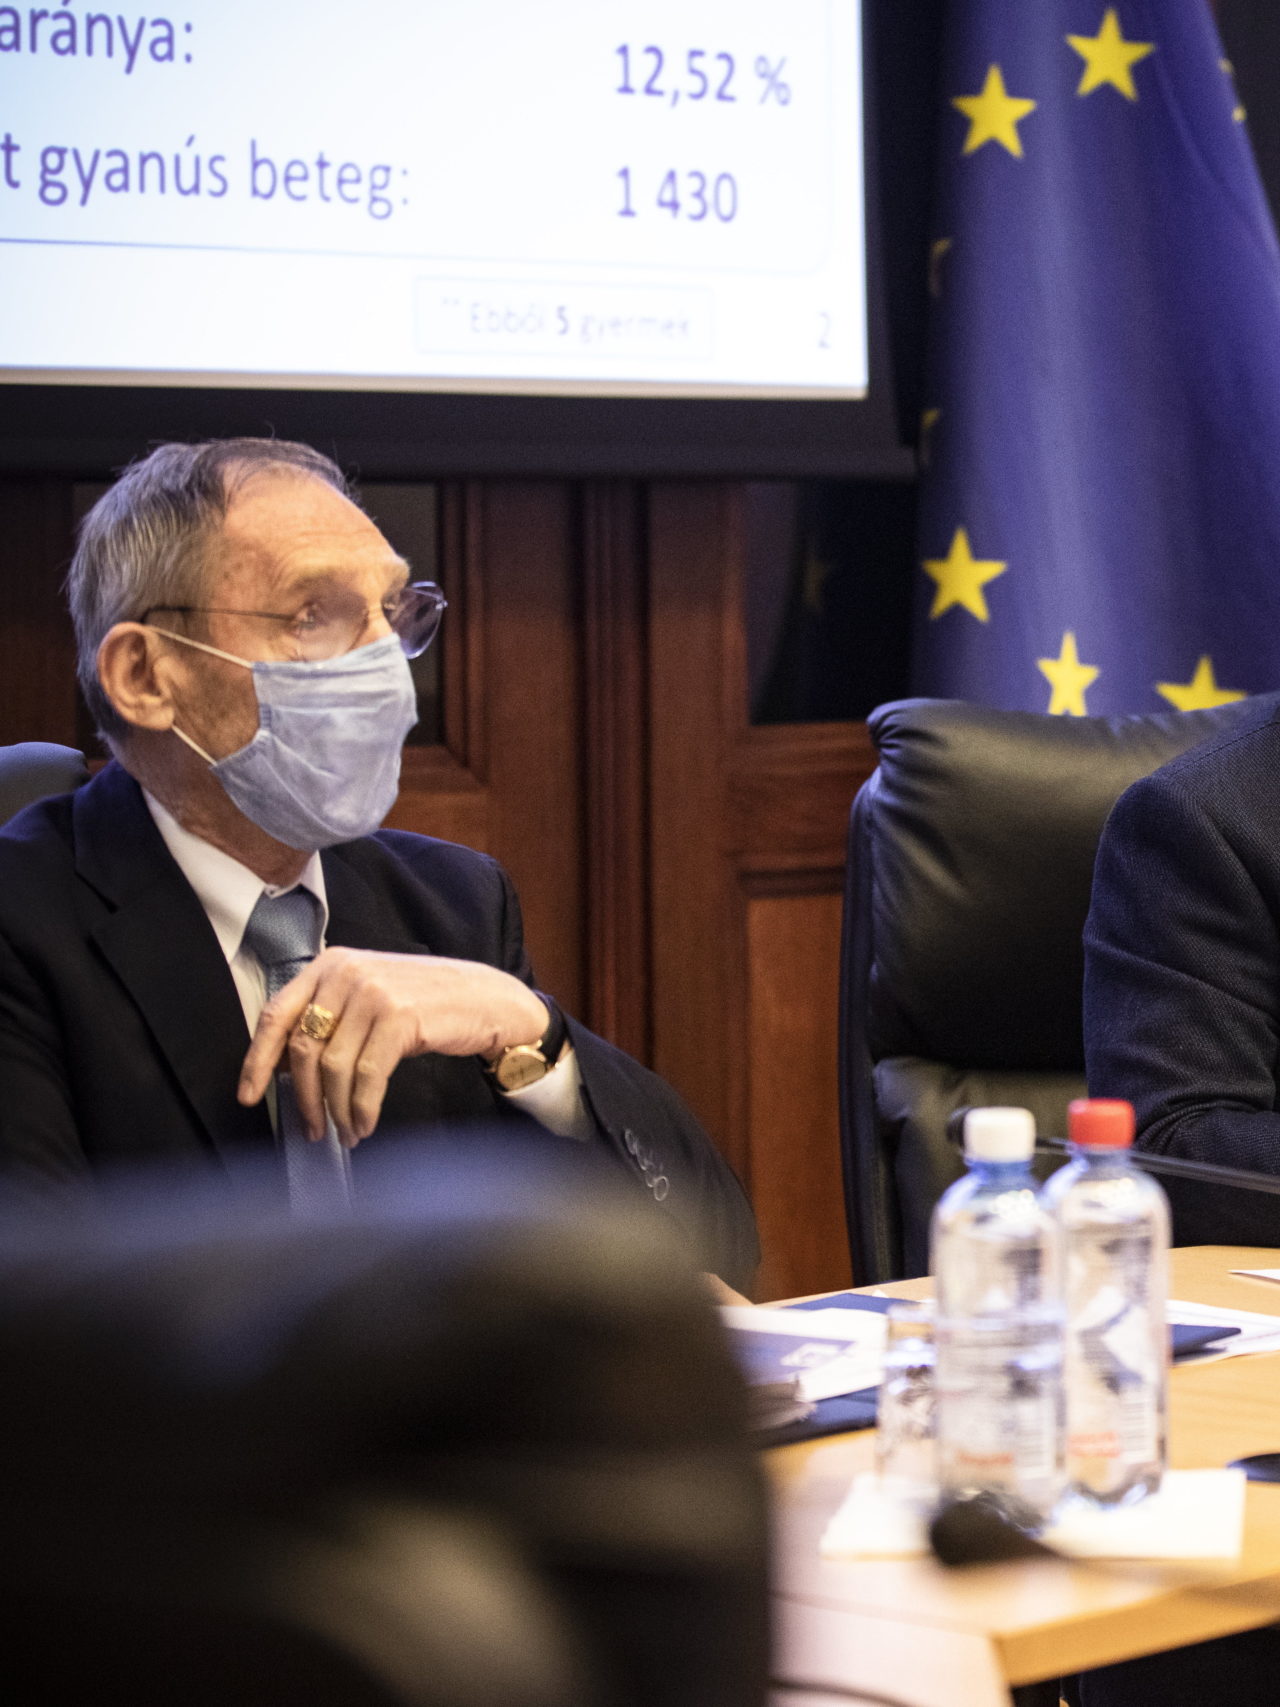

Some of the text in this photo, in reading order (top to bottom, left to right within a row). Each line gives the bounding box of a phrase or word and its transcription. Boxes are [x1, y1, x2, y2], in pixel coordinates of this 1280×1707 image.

[0, 0, 193, 75] aránya:
[615, 43, 792, 107] 12,52 %
[38, 134, 228, 208] gyanús
[249, 138, 408, 220] beteg:
[656, 168, 738, 223] 430
[555, 304, 571, 337] 5
[816, 310, 833, 350] 2
